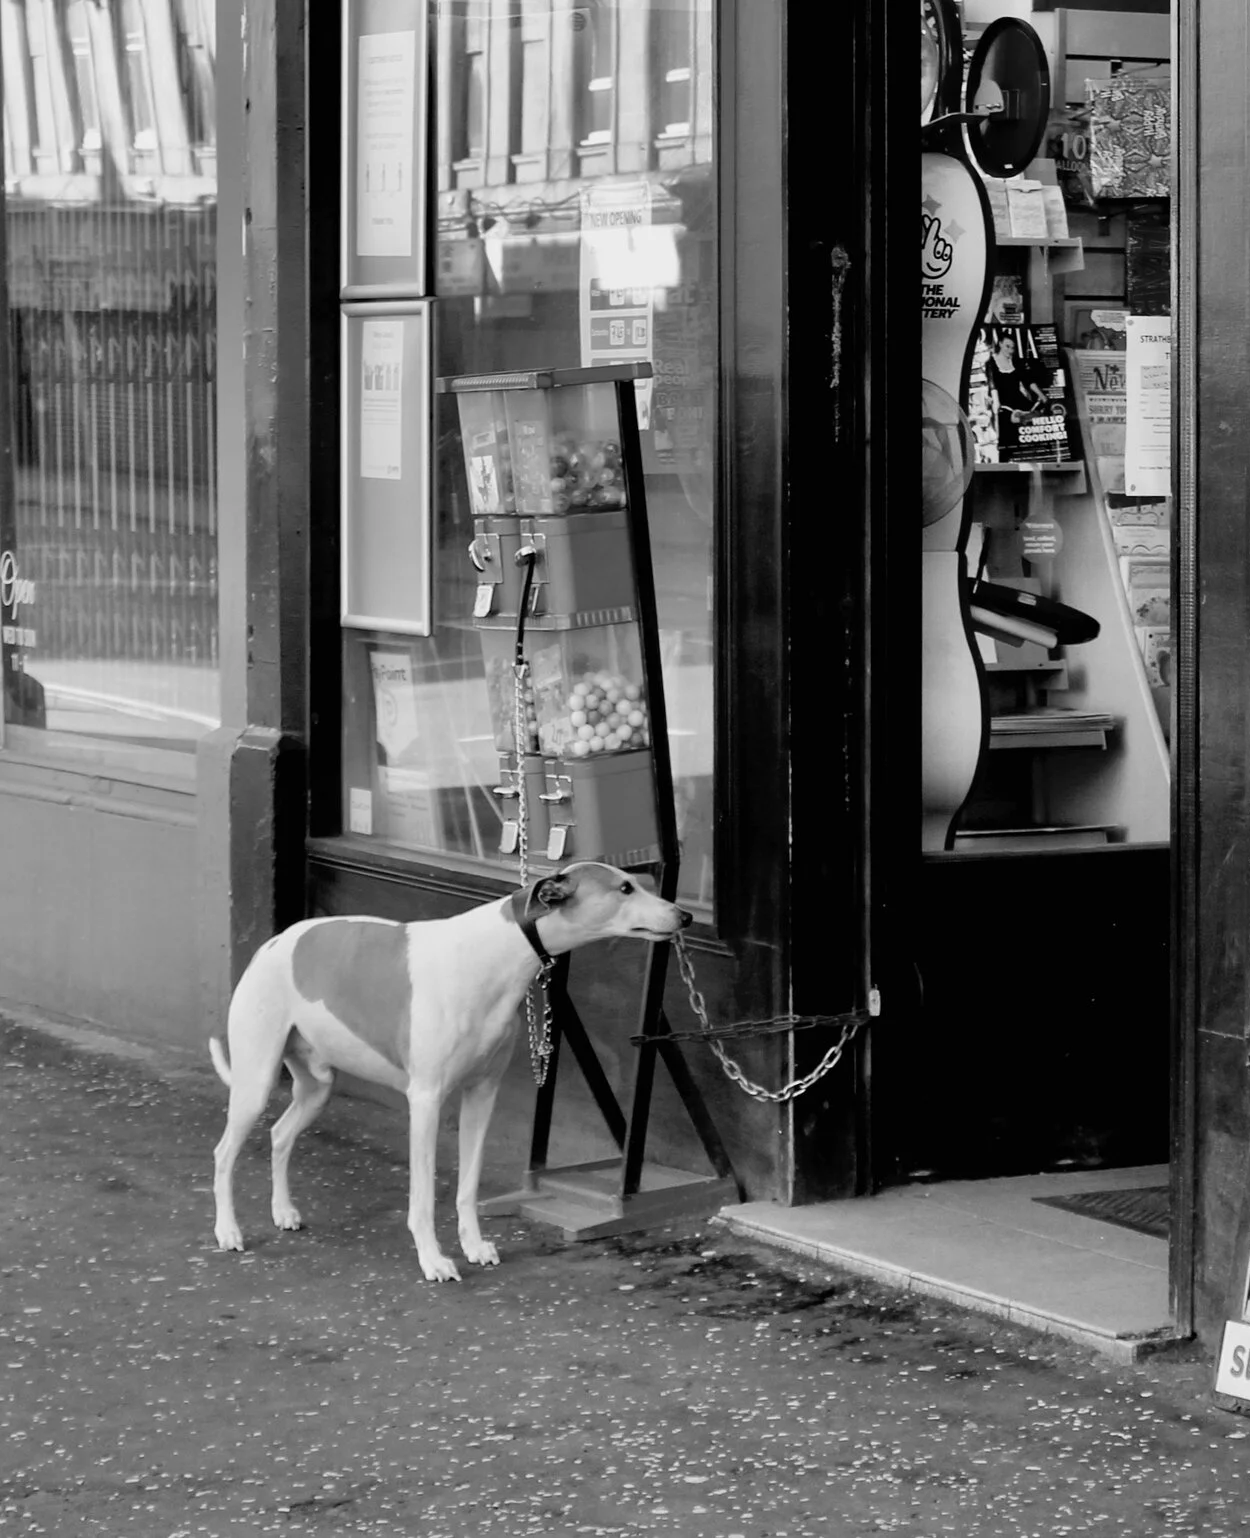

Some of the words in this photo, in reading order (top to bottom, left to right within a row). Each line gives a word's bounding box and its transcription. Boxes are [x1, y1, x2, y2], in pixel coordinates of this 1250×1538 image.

[1061, 132, 1086, 160] 10
[1032, 415, 1065, 426] HELLO
[1018, 423, 1066, 435] COMFORT
[1018, 431, 1068, 443] COOKING!
